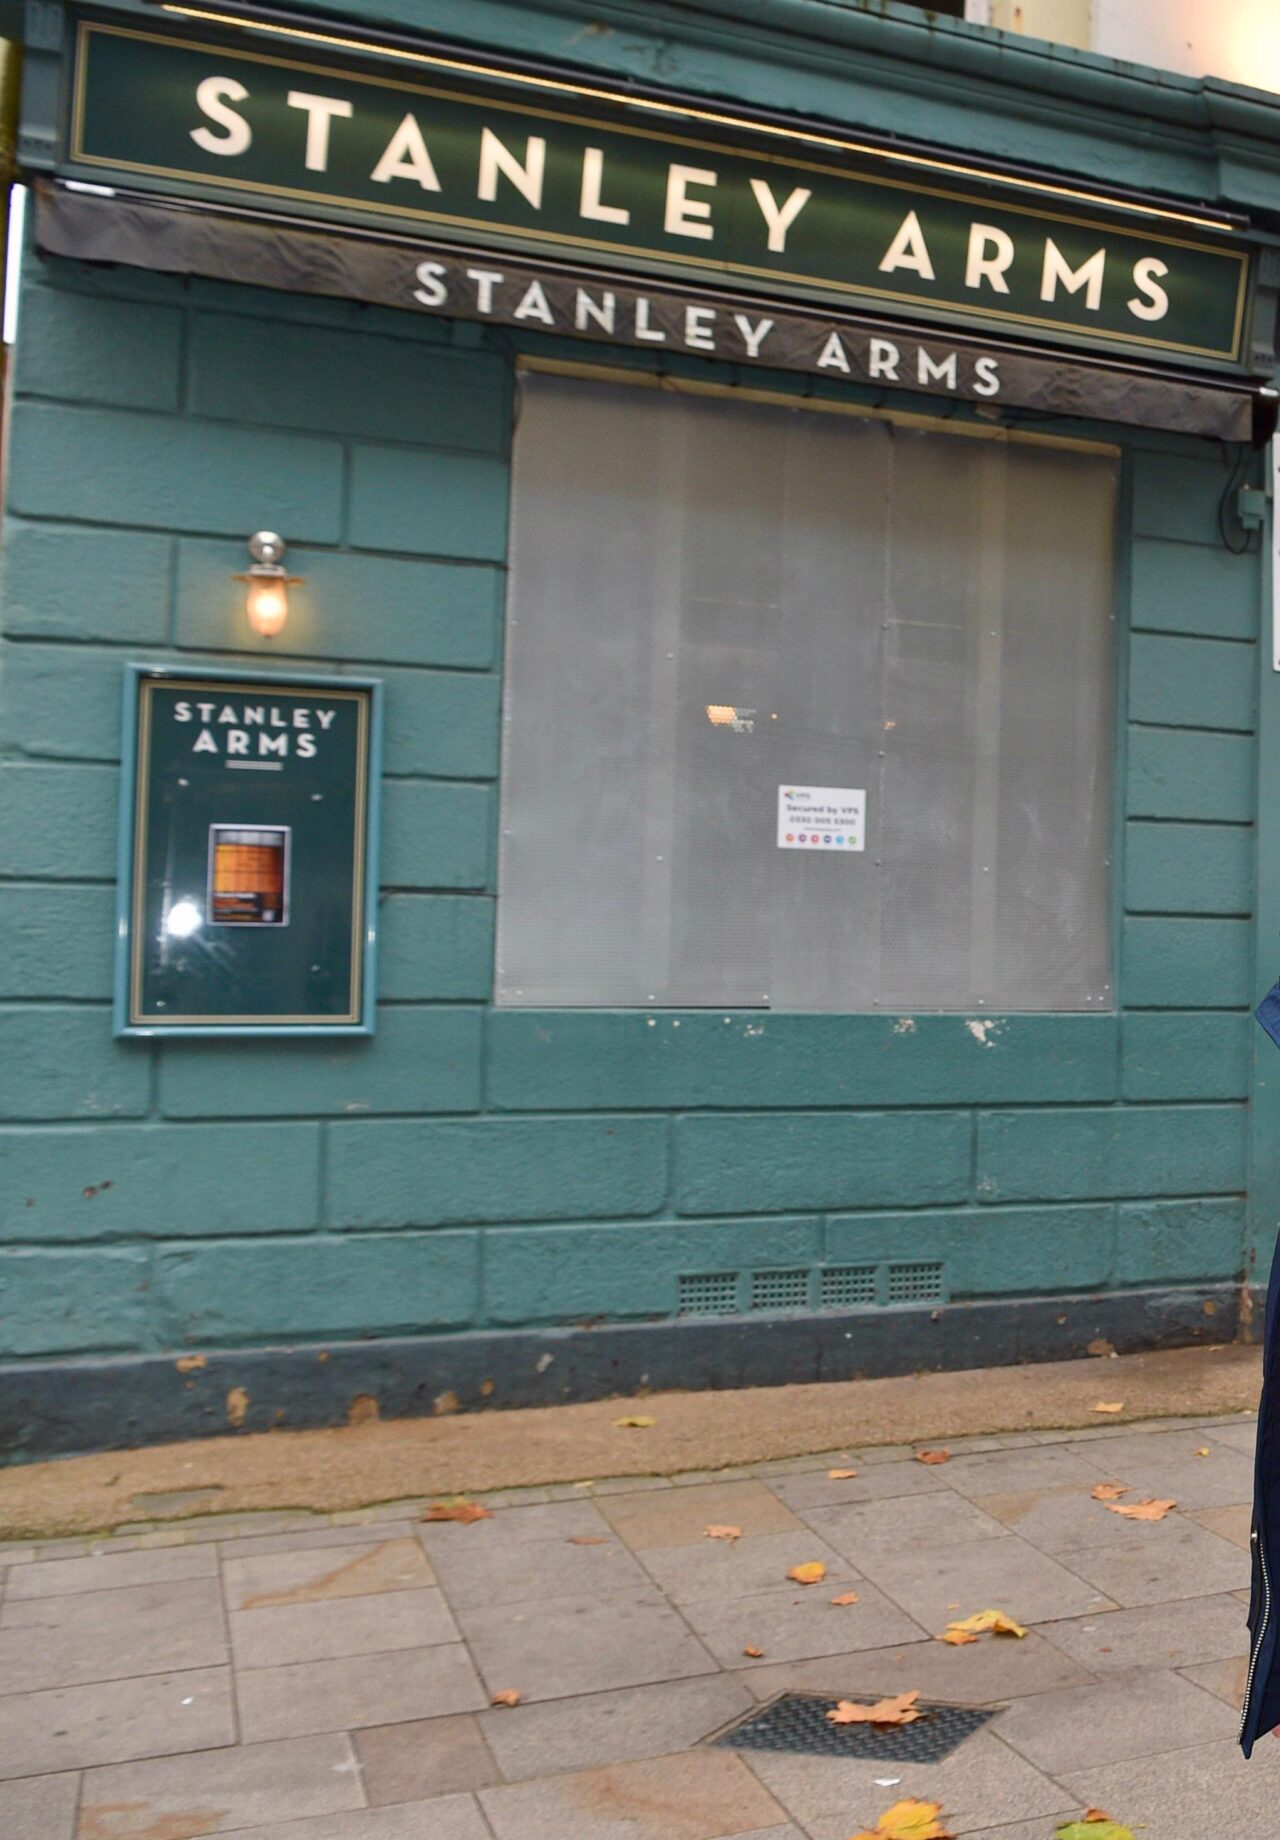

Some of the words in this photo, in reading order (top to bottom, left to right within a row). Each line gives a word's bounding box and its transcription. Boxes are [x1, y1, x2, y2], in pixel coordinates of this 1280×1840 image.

[189, 76, 812, 253] STANLEY
[879, 210, 1170, 322] ARMS
[412, 262, 775, 358] STANLEY
[816, 331, 1002, 397] ARMS
[174, 701, 337, 730] STANLEY
[191, 729, 318, 758] ARMS
[787, 804, 824, 813] Secured
[827, 806, 838, 815] by
[841, 807, 859, 815] VPS
